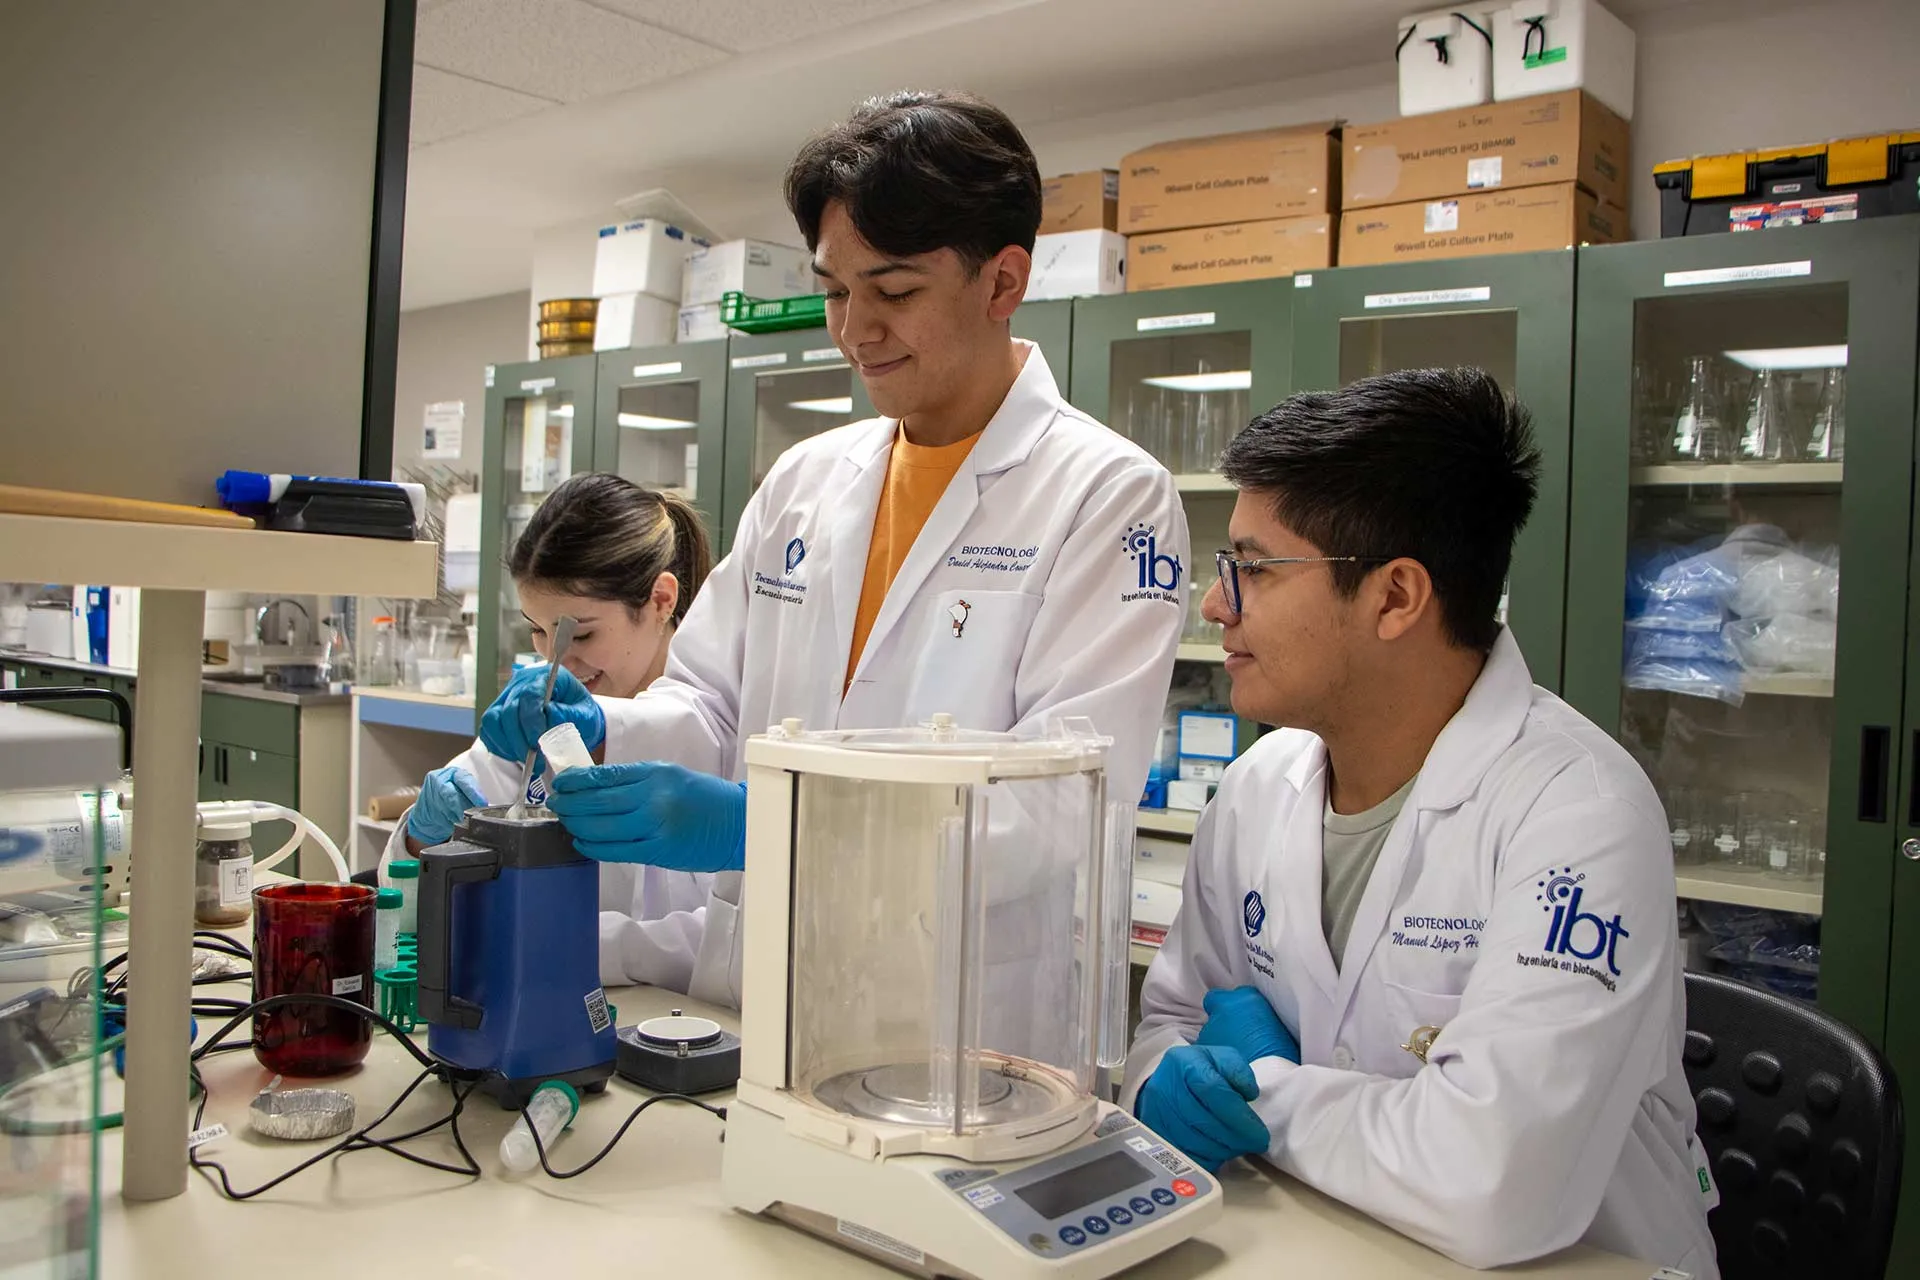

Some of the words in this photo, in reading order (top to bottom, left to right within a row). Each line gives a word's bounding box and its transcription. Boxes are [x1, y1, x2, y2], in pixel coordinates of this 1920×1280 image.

[1422, 145, 1458, 158] Culture
[1460, 142, 1479, 153] Cell
[1397, 151, 1420, 162] Plat
[1195, 181, 1211, 190] Cell
[1212, 178, 1245, 188] Culture
[1246, 175, 1269, 185] Plate
[1428, 238, 1447, 249] Cell
[1449, 235, 1485, 246] Culture
[1487, 231, 1514, 242] Plate
[1200, 260, 1216, 270] Cell
[1218, 258, 1248, 268] Culture
[1250, 255, 1273, 264] Plate
[1392, 931, 1428, 947] Manuel
[1544, 886, 1630, 977] ibt
[1560, 961, 1573, 971] en
